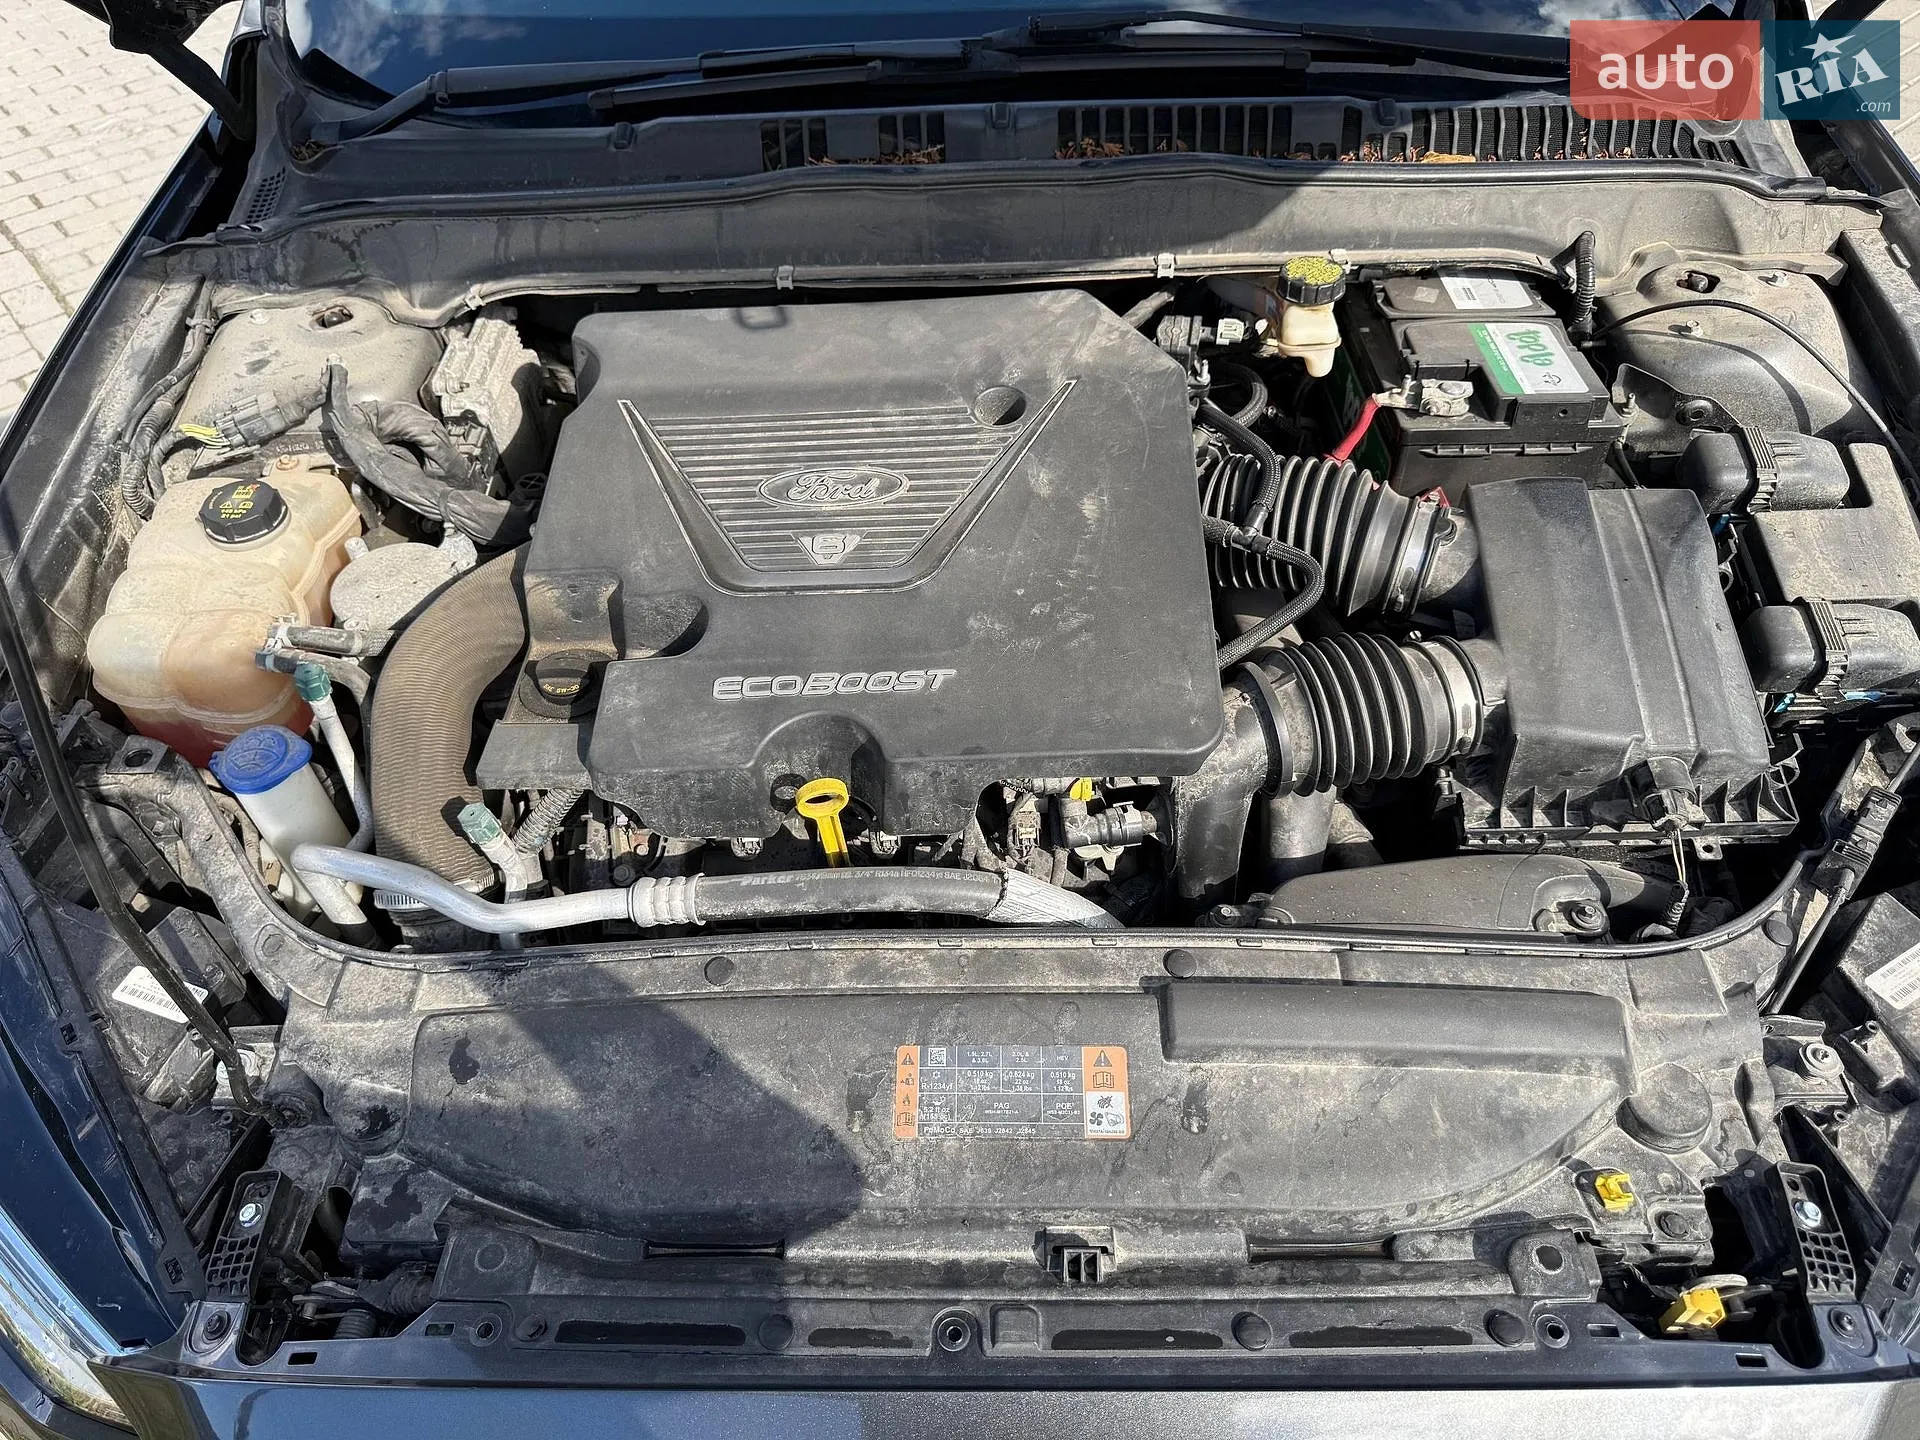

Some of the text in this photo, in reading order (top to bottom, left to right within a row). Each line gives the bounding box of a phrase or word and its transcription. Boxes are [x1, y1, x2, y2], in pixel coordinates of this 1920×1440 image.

[786, 471, 881, 500] Ford
[712, 669, 958, 700] ECOBOOST
[740, 874, 795, 886] Parker
[944, 871, 961, 880] SAE
[921, 1082, 953, 1091] R-1234yf
[923, 1126, 955, 1134] FoMoCo
